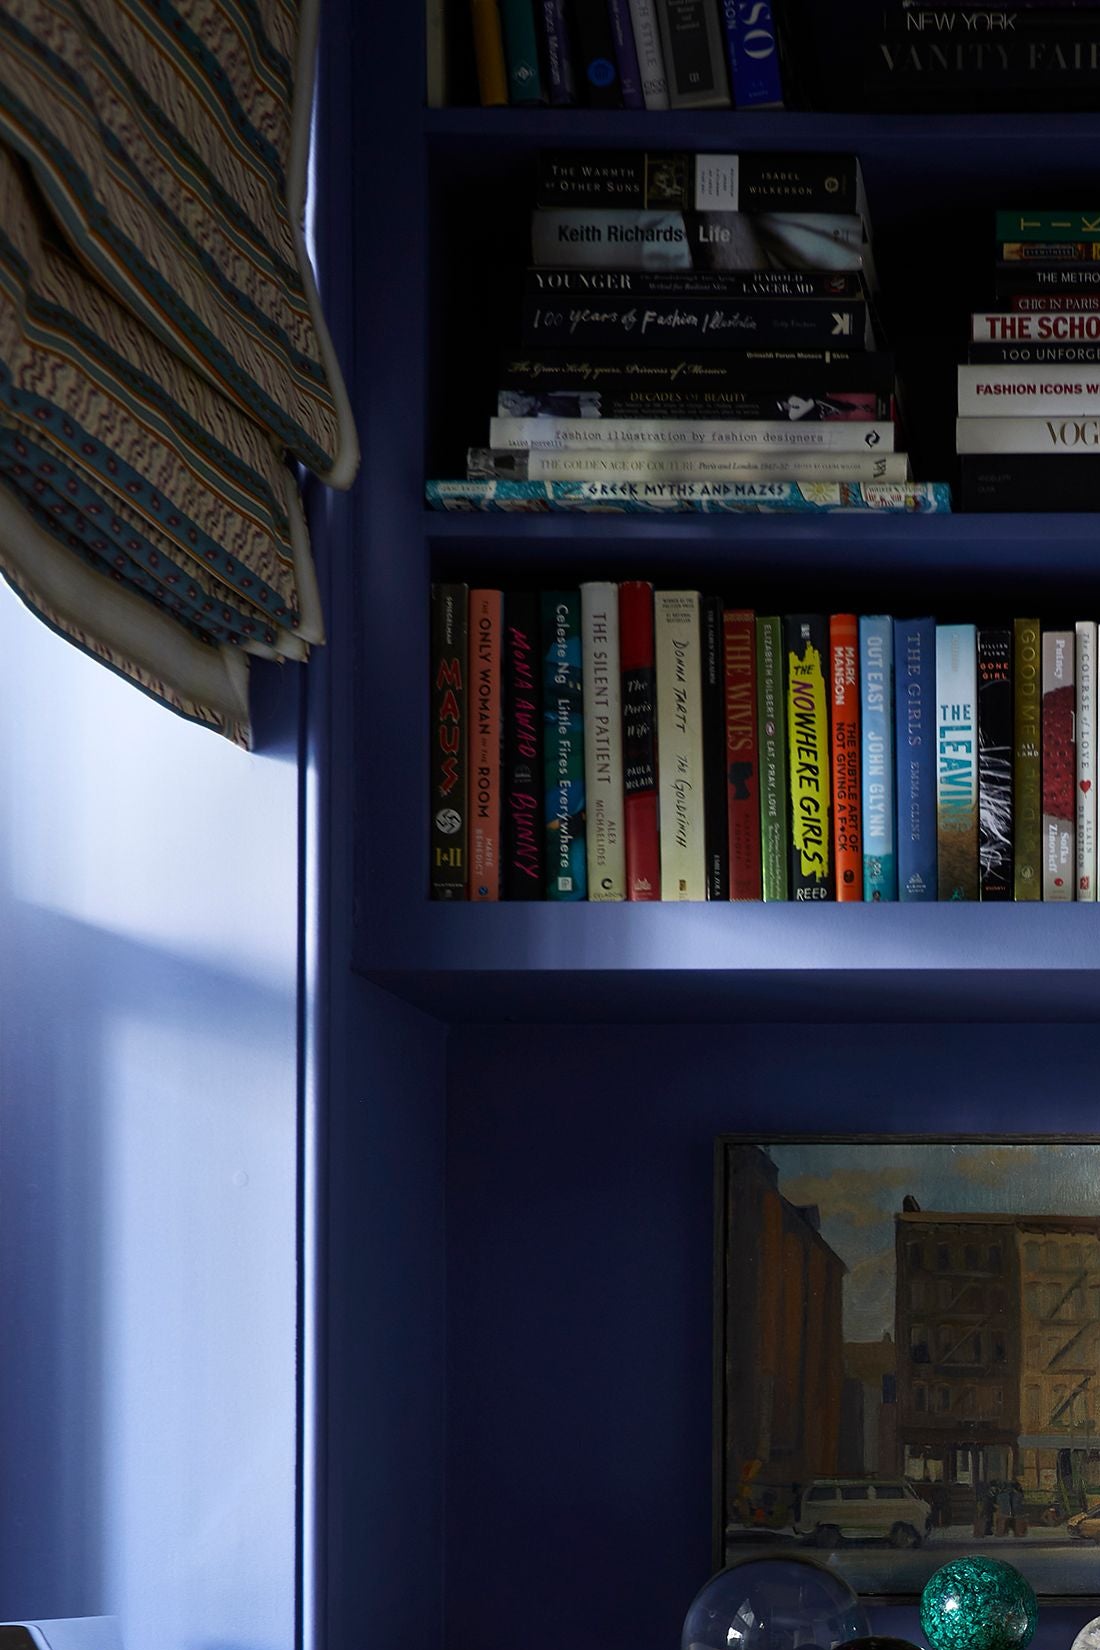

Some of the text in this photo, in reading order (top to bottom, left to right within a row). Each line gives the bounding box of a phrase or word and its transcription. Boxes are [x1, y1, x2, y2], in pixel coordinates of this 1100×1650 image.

[907, 12, 1017, 31] NEW YORK
[880, 42, 1008, 71] VANITY
[560, 181, 641, 193] OTHER SUNS
[558, 224, 731, 242] Keith Richards Life
[535, 273, 633, 290] YOUNGER
[1036, 272, 1058, 283] THE
[1019, 298, 1099, 310] CHIC IN PARIS
[986, 317, 1032, 339] THE
[976, 384, 1036, 395] FASHION
[1040, 384, 1083, 394] ICONS
[555, 430, 823, 443] fashion illustration by fashion designers
[588, 482, 784, 496] GREEK MYTHS AND MAZES
[477, 617, 492, 662] ONLY
[794, 664, 815, 676] THE
[835, 646, 845, 706] MANSON
[845, 646, 855, 686] MARK
[477, 668, 492, 734] WOMAN
[592, 612, 611, 785] THE SILENT PATIENT
[726, 629, 753, 751] THE WIVES
[940, 704, 972, 721] THE
[1080, 653, 1092, 769] COURSE LOVE
[554, 604, 572, 869] Celeste Ng Little Fires Everywhere
[867, 636, 886, 837] OUT EAST JOHN GLYNN
[792, 679, 823, 868] NOWHERE GIRLS
[837, 722, 847, 813] NOT GIVING A
[476, 767, 491, 818] ROOM
[846, 722, 858, 853] THE SUBTLE ART OF
[607, 820, 617, 845] ALEX
[796, 888, 827, 900] REED
